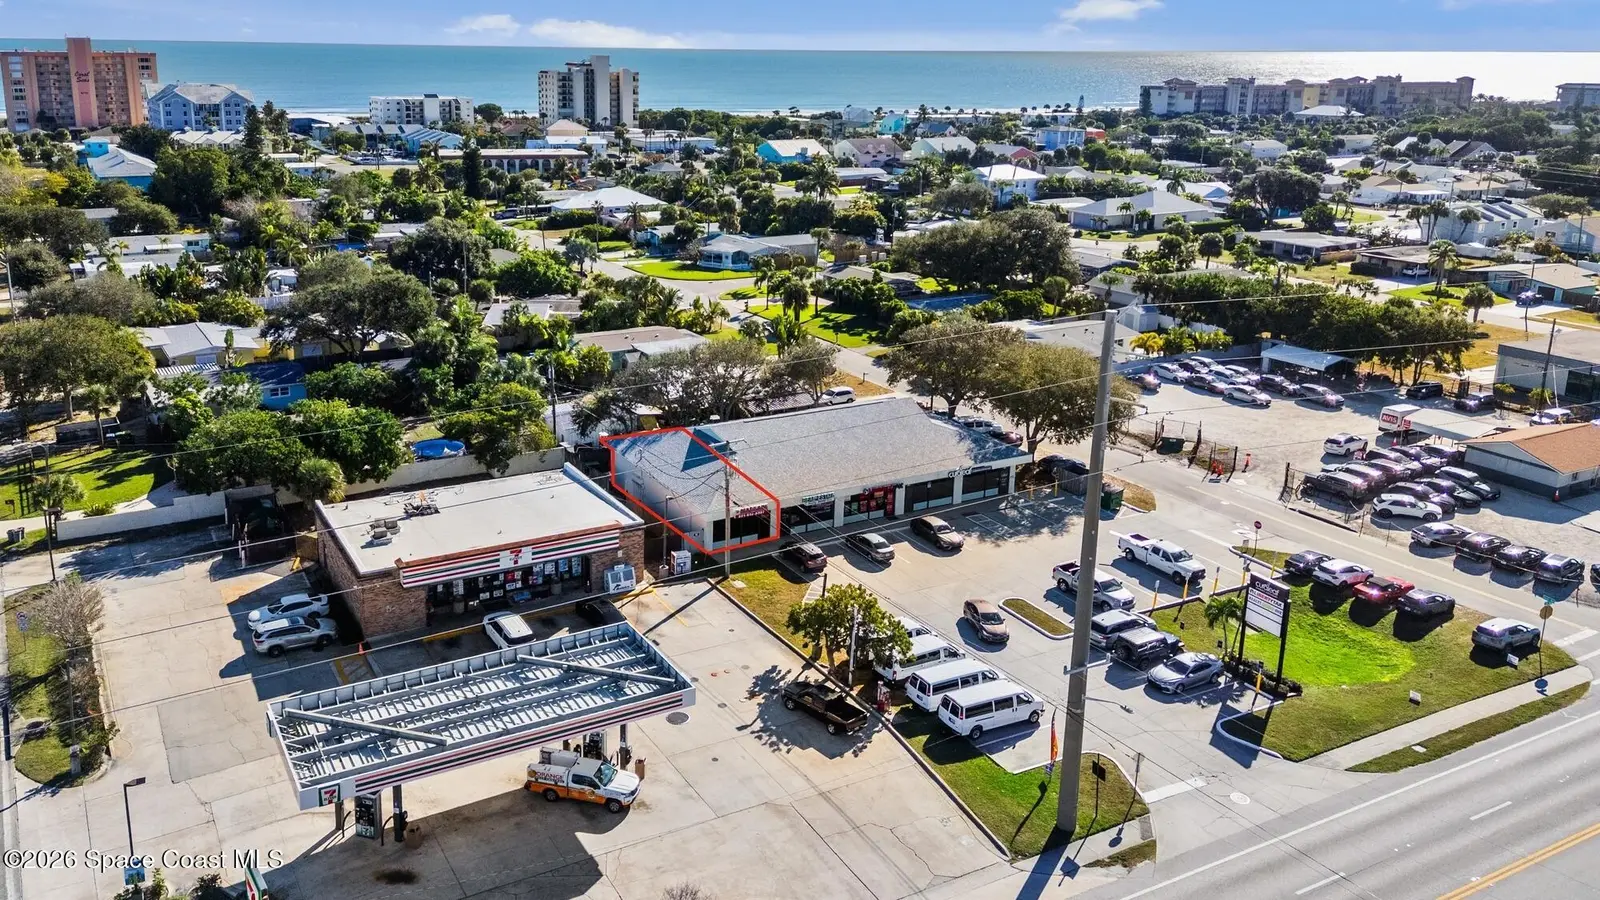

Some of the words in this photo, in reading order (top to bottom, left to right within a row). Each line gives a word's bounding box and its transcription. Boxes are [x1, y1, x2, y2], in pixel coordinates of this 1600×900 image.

[1383, 414, 1397, 423] AVIS
[536, 771, 563, 780] ORANGE
[323, 789, 337, 804] 7
